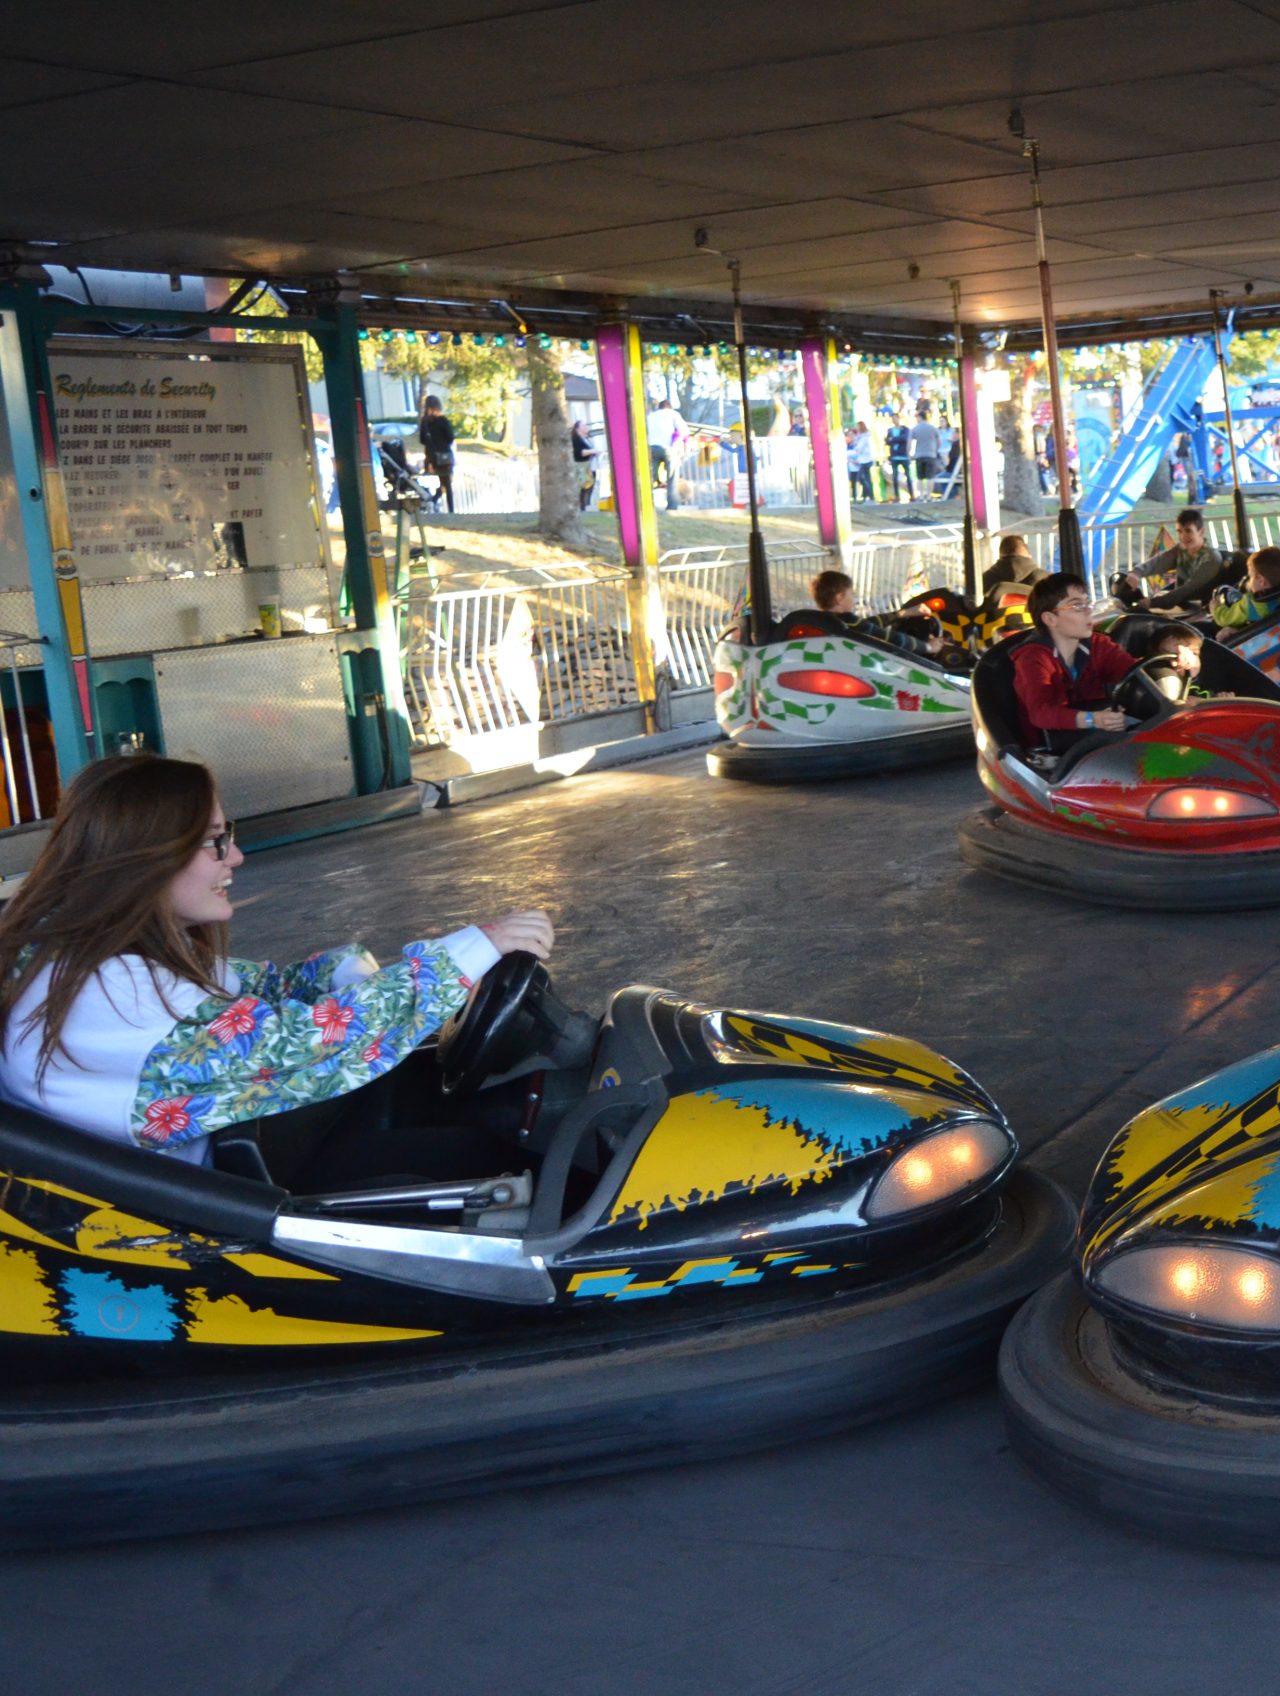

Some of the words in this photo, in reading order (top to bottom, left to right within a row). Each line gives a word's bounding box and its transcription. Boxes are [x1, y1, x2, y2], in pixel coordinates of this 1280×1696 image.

[55, 373, 136, 402] Reglements
[140, 377, 156, 396] de
[160, 375, 217, 401] Security
[74, 409, 98, 419] MAINS
[102, 409, 112, 419] ET
[116, 409, 128, 419] LES
[133, 409, 152, 419] BRAS
[60, 425, 69, 434] LA
[73, 424, 98, 434] BARRE
[102, 424, 112, 434] DE
[193, 424, 202, 434] EN
[206, 424, 222, 434] TOUT
[226, 424, 248, 434] TEMPS
[94, 440, 107, 449] SUR
[113, 440, 125, 449] LES
[130, 439, 171, 449] PLANCHERS
[74, 454, 93, 465] DANS
[98, 454, 105, 465] LE
[200, 452, 230, 463] COMPLET
[234, 453, 243, 462] DU
